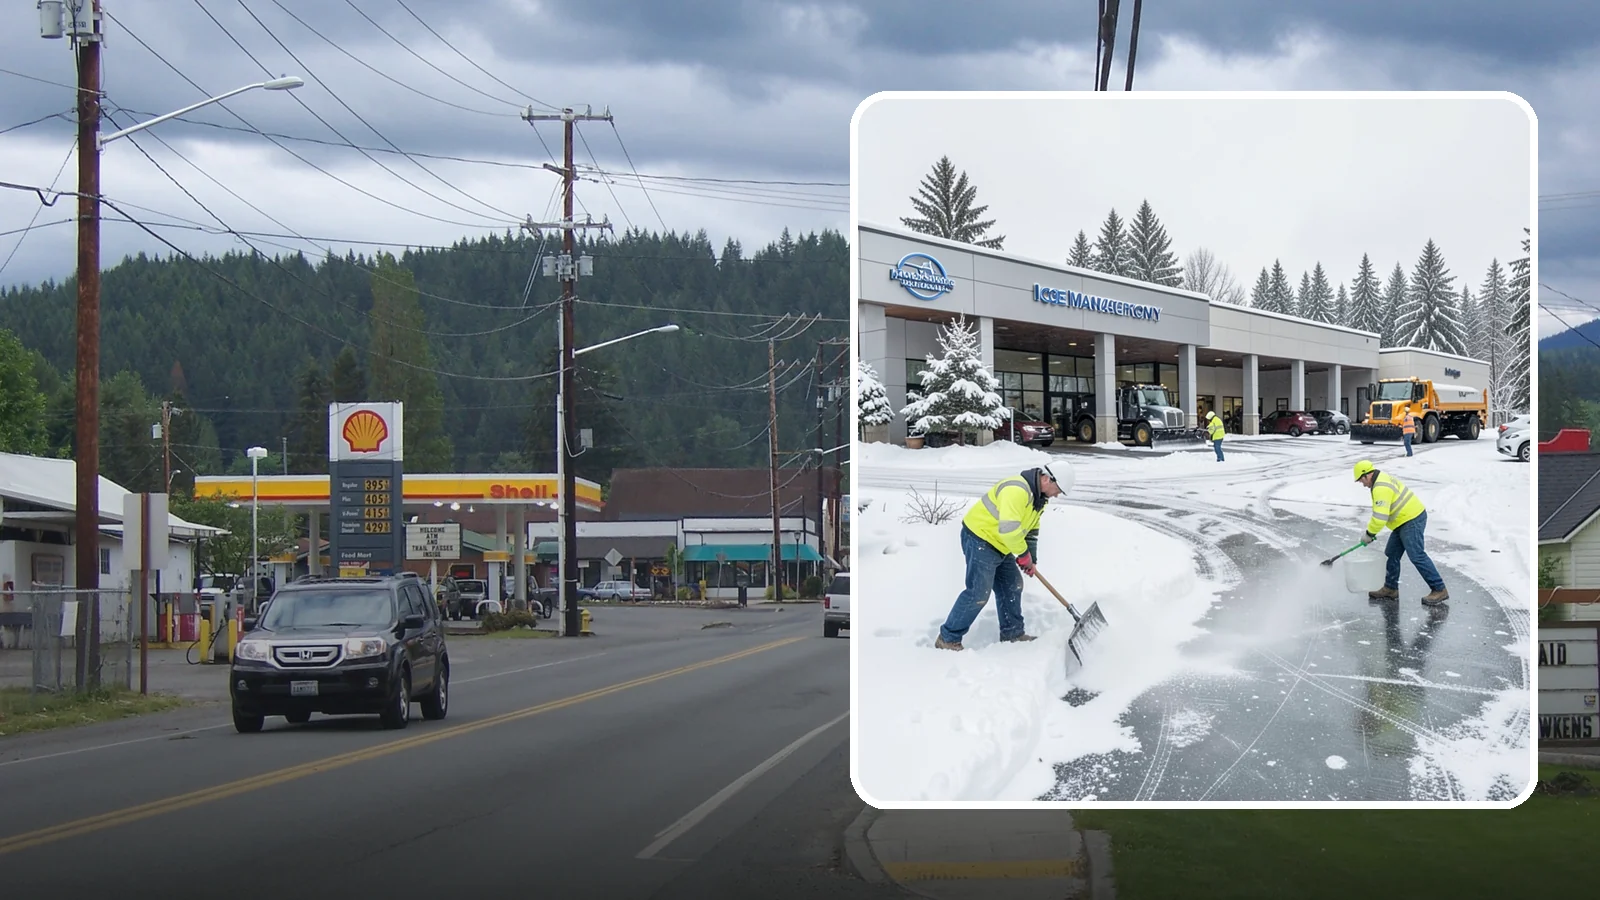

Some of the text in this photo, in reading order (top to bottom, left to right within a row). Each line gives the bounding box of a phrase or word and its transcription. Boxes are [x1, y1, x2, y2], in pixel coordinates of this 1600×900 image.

[366, 480, 384, 490] 395
[490, 484, 547, 499] Shell
[366, 494, 384, 504] 405
[366, 508, 384, 518] 415
[366, 522, 384, 533] 429
